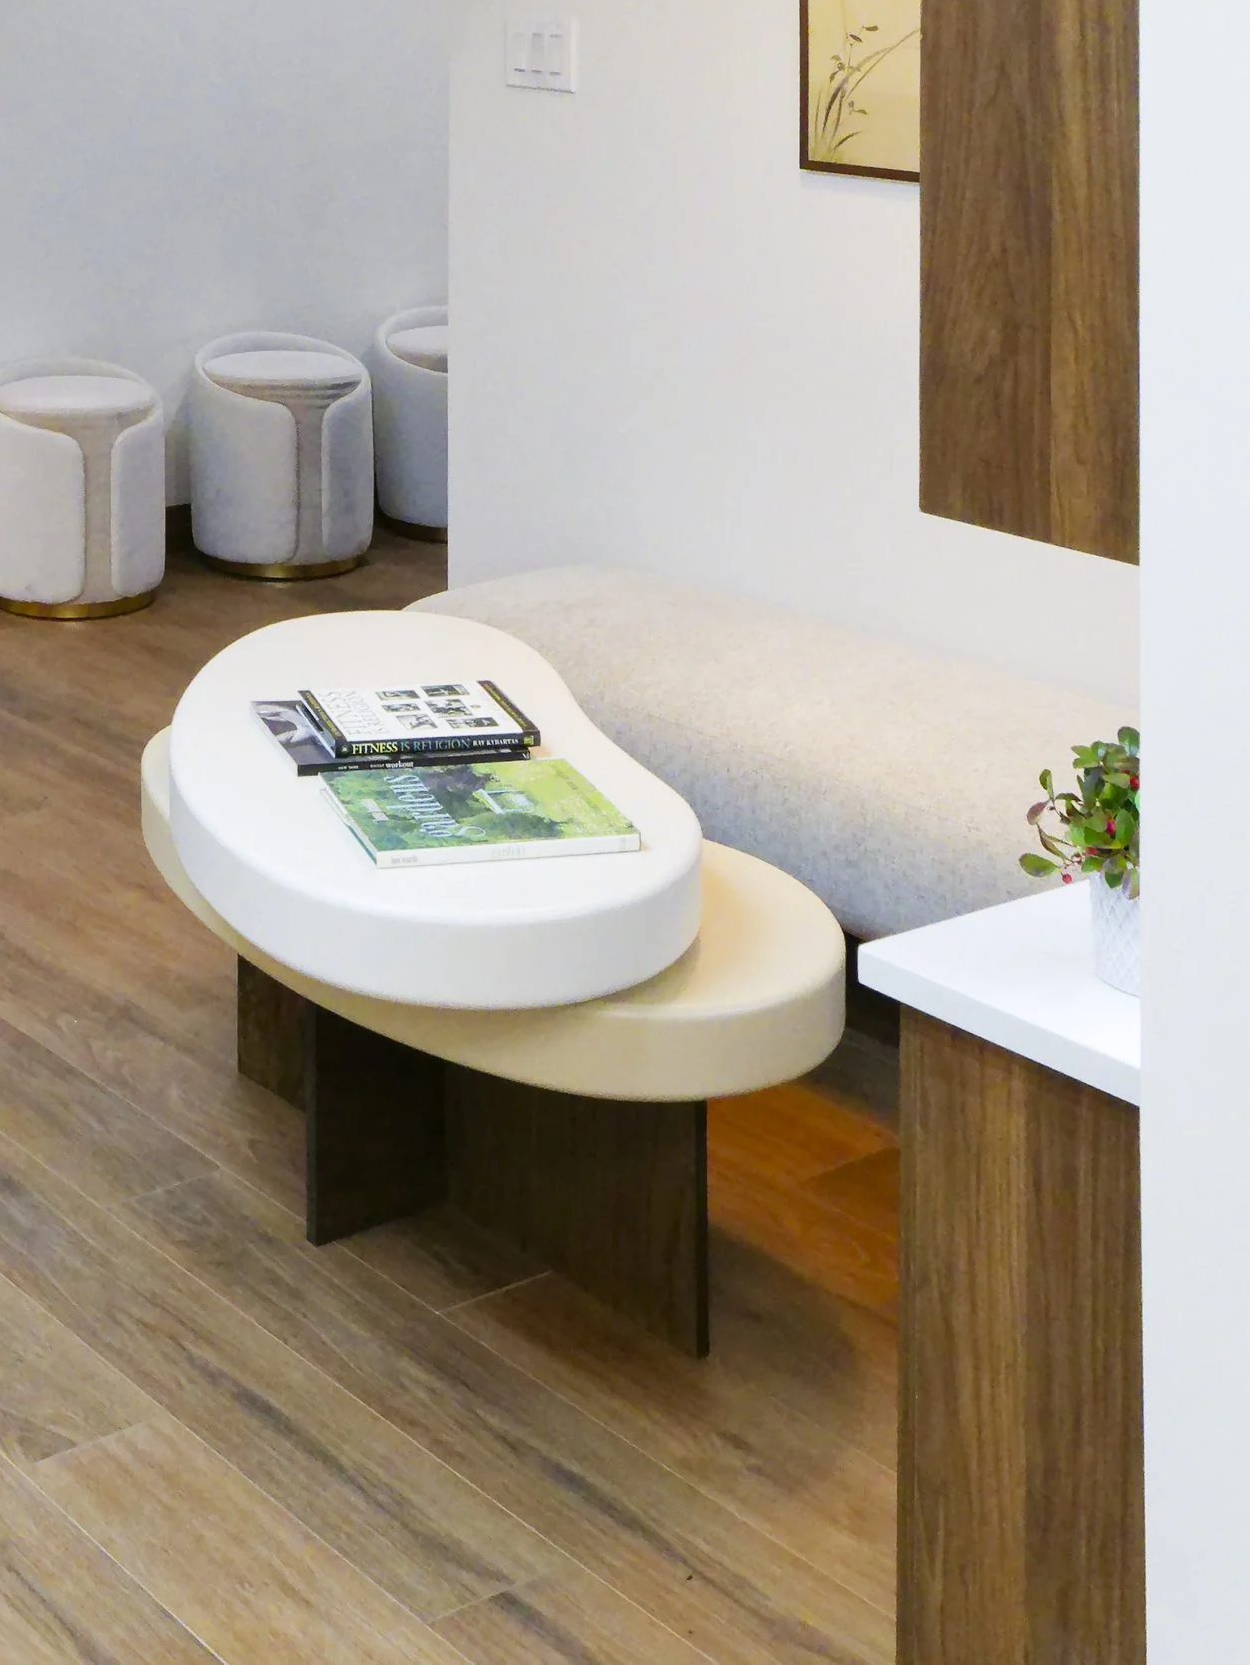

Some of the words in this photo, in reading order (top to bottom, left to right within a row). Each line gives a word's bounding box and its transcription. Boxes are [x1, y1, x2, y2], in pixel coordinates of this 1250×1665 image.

[352, 742, 398, 755] FITNESS
[400, 740, 410, 752] IS
[413, 738, 470, 751] RELIGION
[384, 775, 486, 837] gardens
